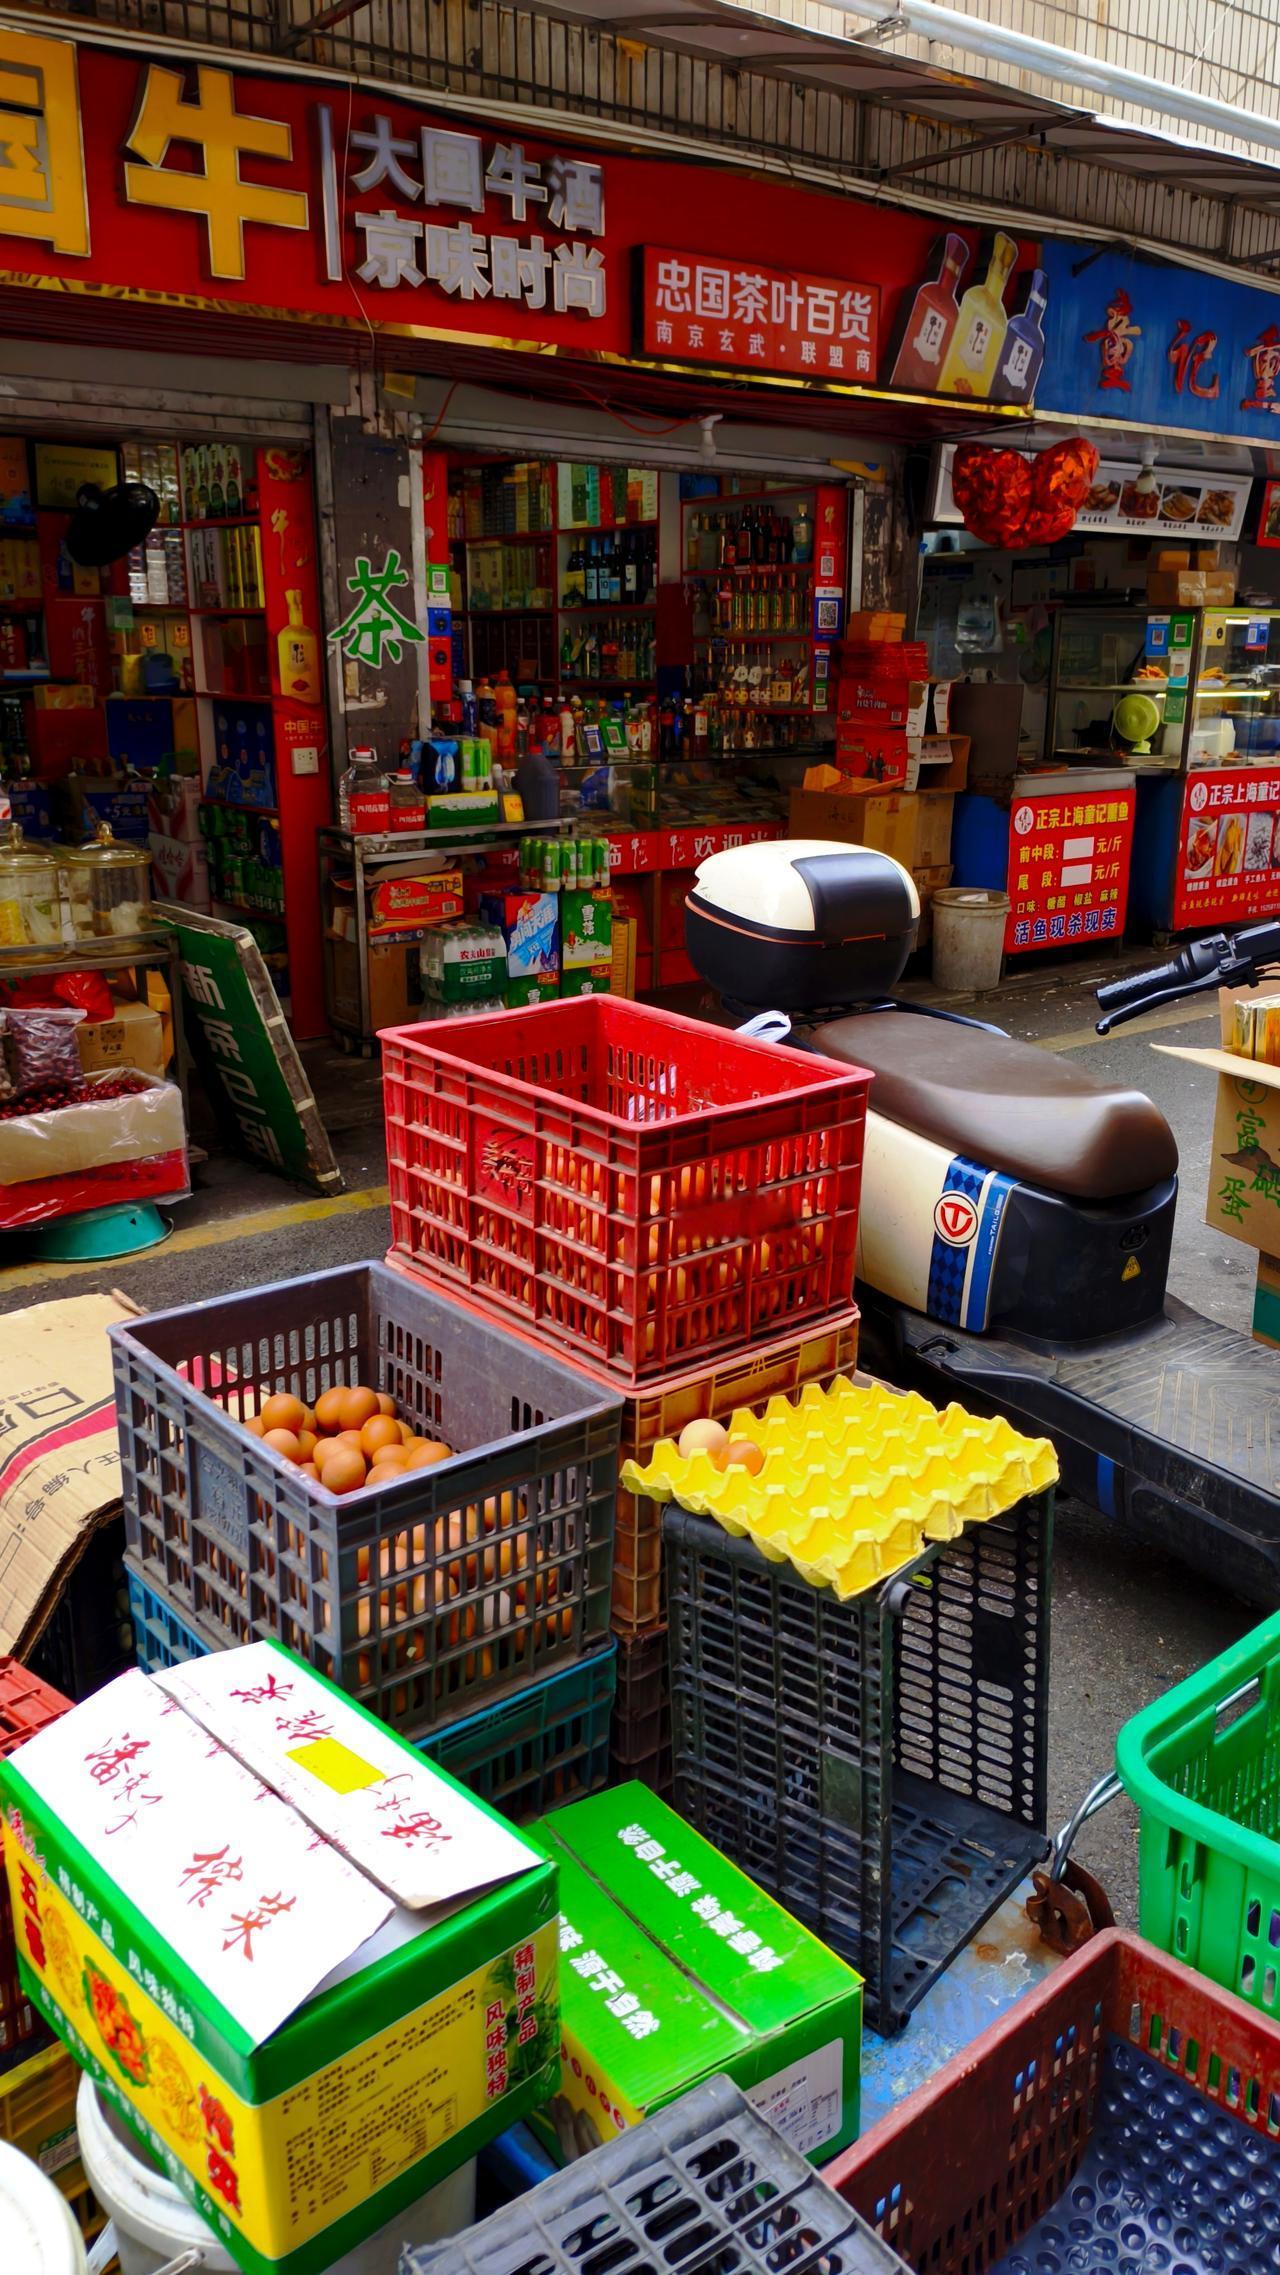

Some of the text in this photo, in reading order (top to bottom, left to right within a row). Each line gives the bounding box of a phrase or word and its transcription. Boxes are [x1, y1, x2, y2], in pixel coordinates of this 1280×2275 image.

[349, 114, 606, 237] 大国牛酒
[354, 209, 607, 318] 京味时尚
[655, 259, 873, 342] 忠国茶叶百货
[326, 548, 428, 669] 茶
[1017, 874, 1029, 890] 尾
[1094, 862, 1120, 881] 元/斤
[1096, 835, 1122, 854] 元/斤
[1014, 906, 1118, 946] 活鱼现杀现卖
[176, 1843, 297, 1963] 榨菜
[617, 1822, 702, 1898] 源于自然
[690, 1893, 785, 1973] 纯香美味
[512, 1942, 537, 2048] 精制产品
[569, 1948, 661, 2041] 源于自然
[484, 1999, 509, 2099] 风味独特
